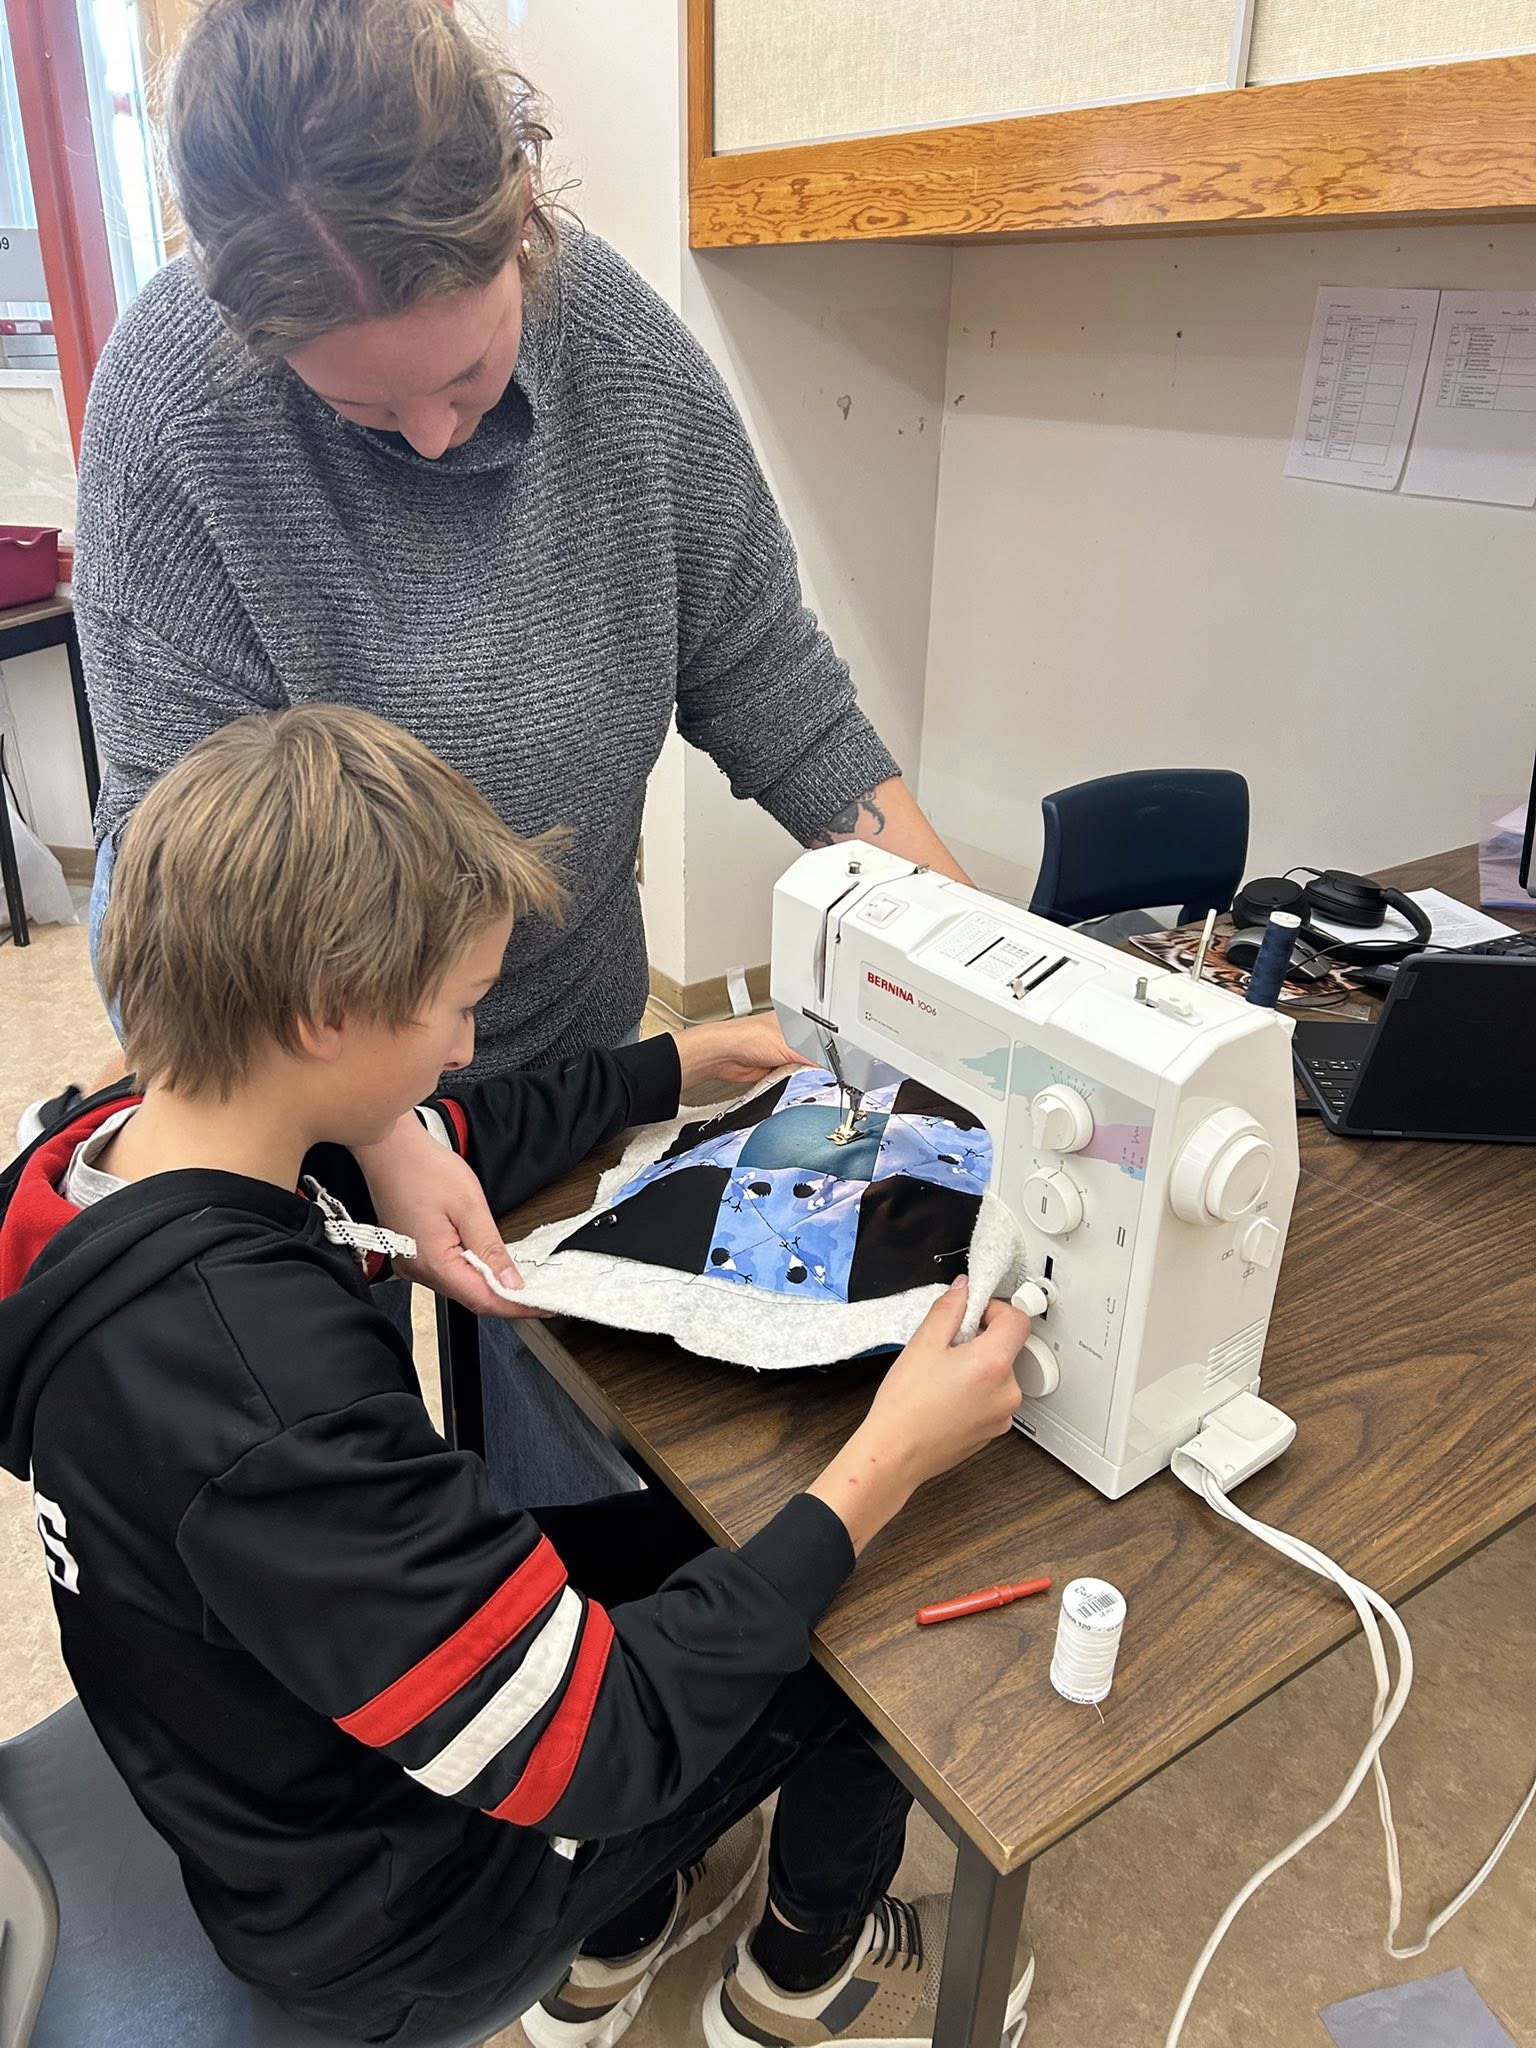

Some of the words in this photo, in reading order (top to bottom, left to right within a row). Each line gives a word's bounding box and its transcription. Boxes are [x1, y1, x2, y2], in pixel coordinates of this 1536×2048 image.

[867, 971, 914, 1005] BERNINA
[917, 999, 937, 1017] 1006
[30, 1458, 80, 1595] S
